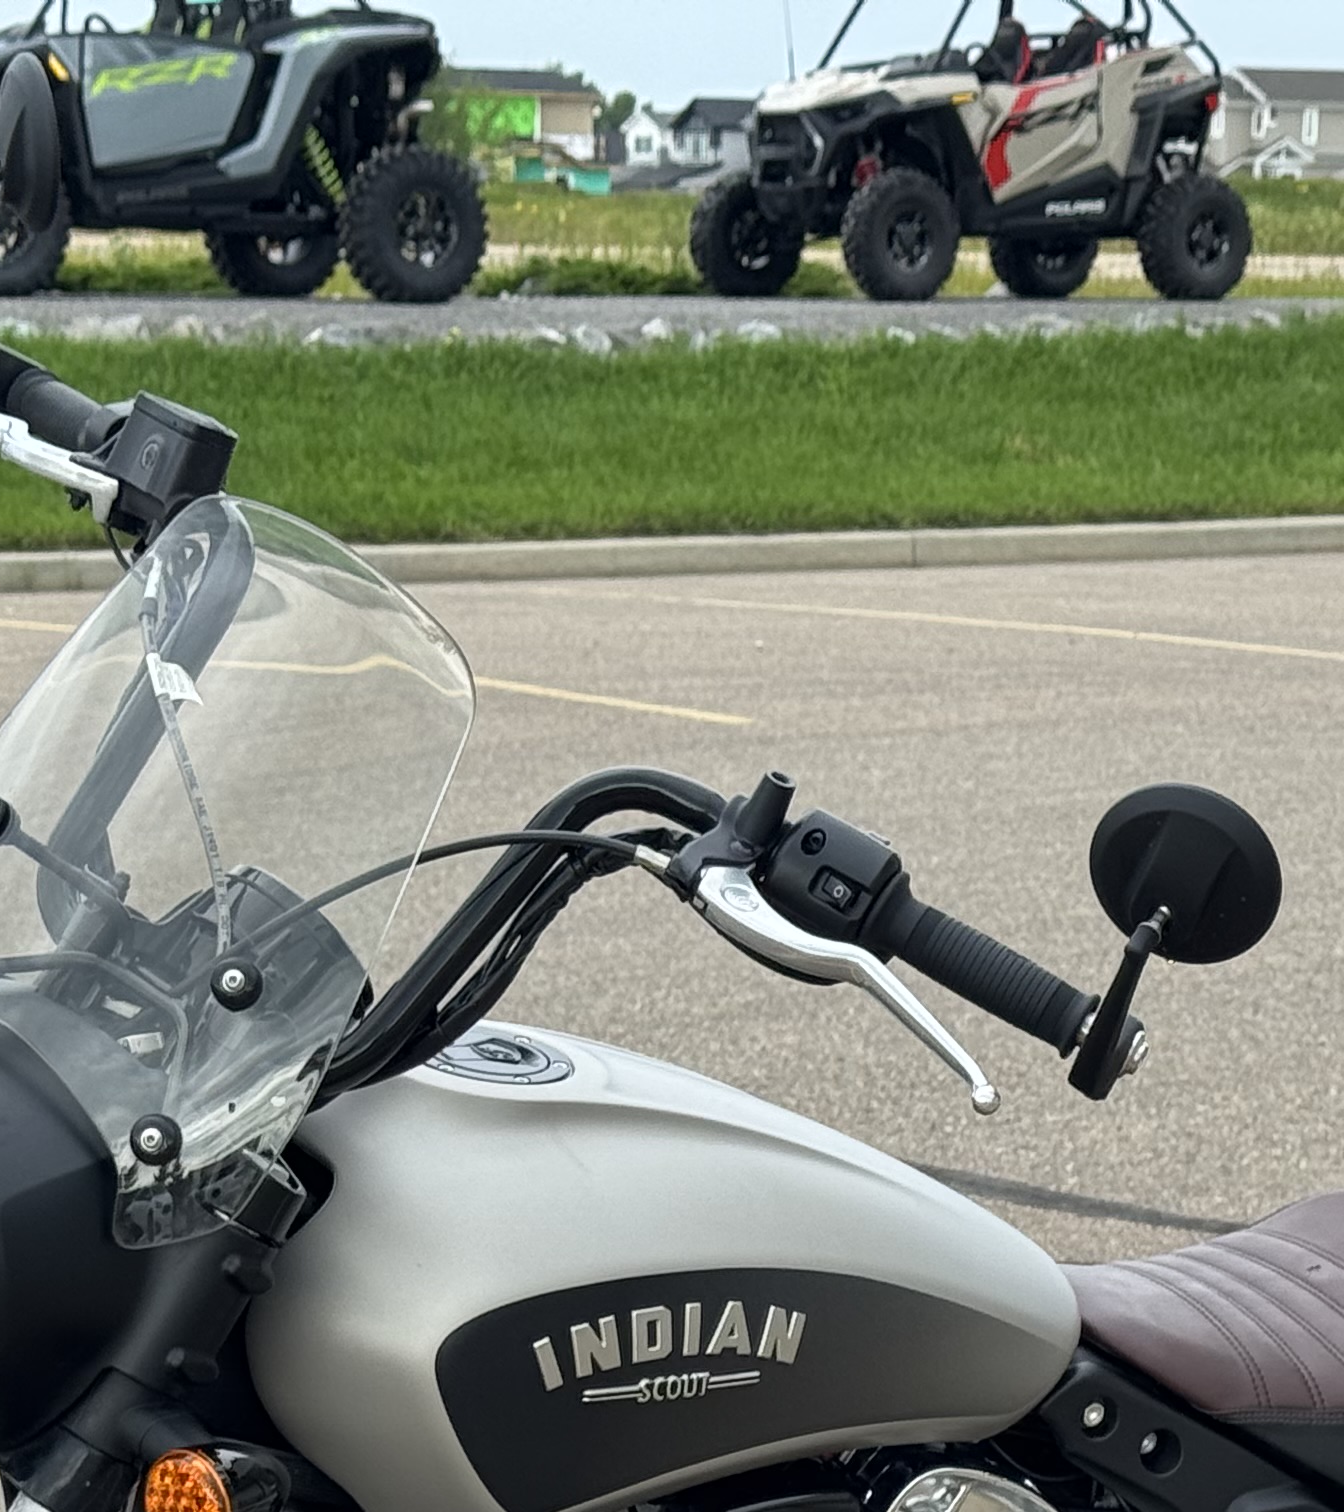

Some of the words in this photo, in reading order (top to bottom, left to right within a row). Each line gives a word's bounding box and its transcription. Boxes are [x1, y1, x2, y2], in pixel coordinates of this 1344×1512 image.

[90, 51, 238, 98] RZR
[532, 1299, 807, 1392] INDIAN
[636, 1371, 711, 1404] SCOUT
